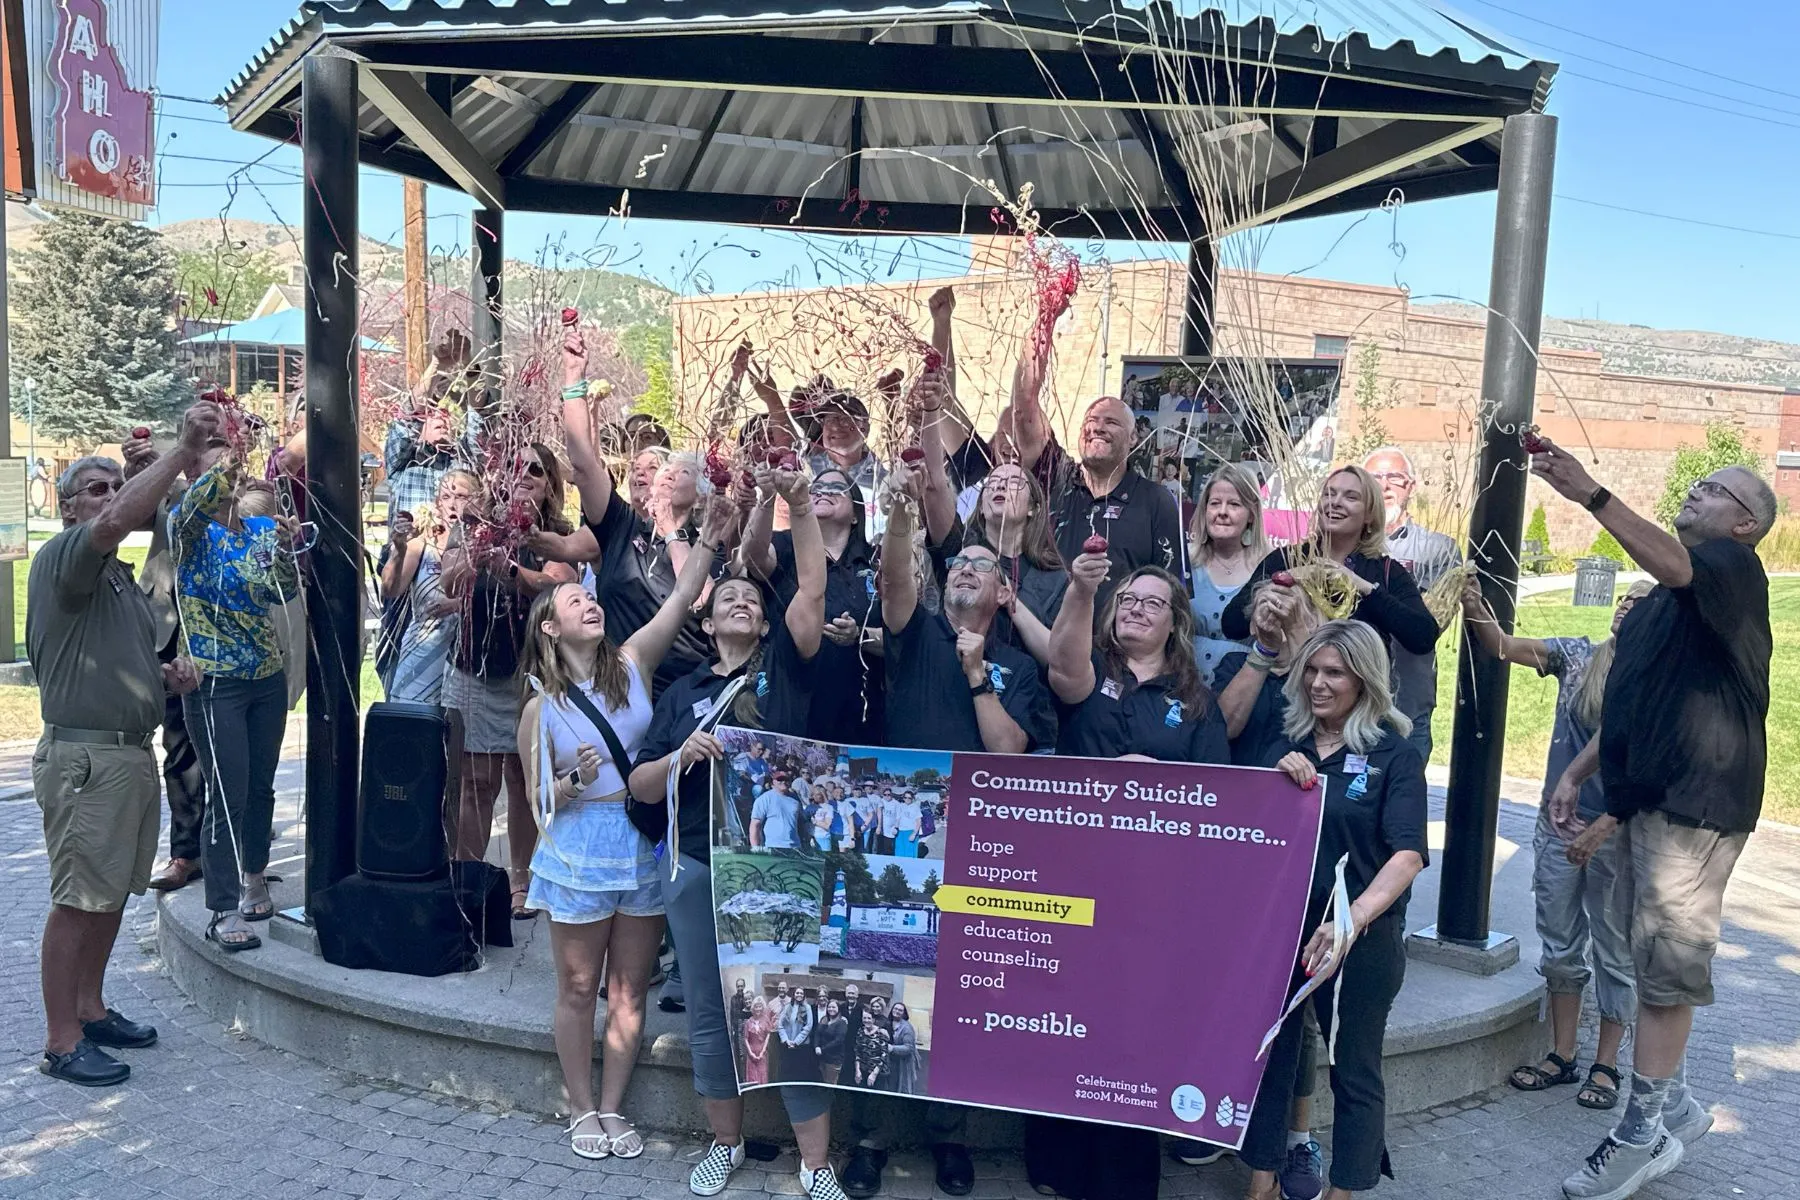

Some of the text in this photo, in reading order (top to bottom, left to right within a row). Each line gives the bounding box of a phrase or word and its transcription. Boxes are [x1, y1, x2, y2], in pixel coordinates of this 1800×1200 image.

[383, 784, 407, 801] JBL
[971, 770, 1218, 807] Community Suicide
[967, 797, 1287, 847] Prevention makes more...
[969, 834, 1014, 858] hope
[968, 864, 1038, 883] support
[966, 895, 1072, 919] community
[963, 920, 1053, 945] education
[961, 949, 1060, 974] counseling
[960, 971, 1005, 989] good
[984, 1011, 1087, 1038] possible
[1076, 1074, 1158, 1095] Celebrating the
[1075, 1089, 1158, 1109] $200M Moment
[1650, 1134, 1668, 1159] HOKA
